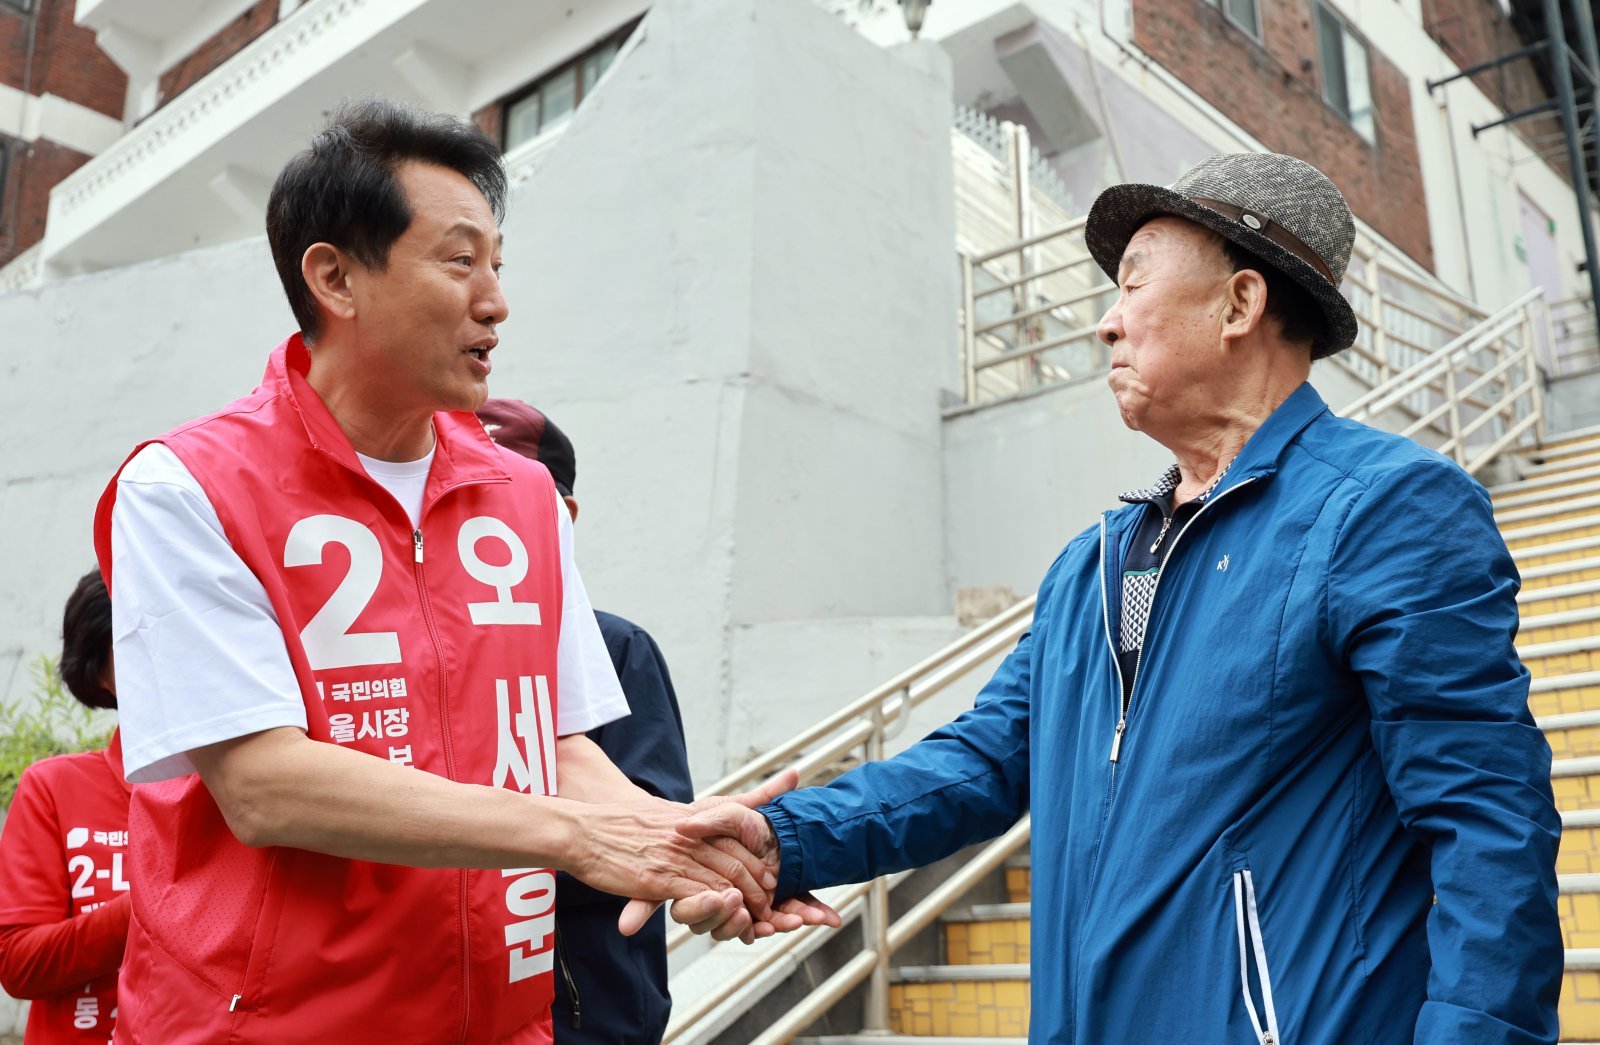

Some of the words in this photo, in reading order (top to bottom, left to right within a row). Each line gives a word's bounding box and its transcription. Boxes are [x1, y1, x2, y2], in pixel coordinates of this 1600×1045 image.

[284, 514, 402, 671] 2
[331, 677, 408, 703] 국민의힘
[328, 707, 410, 743] 울시장
